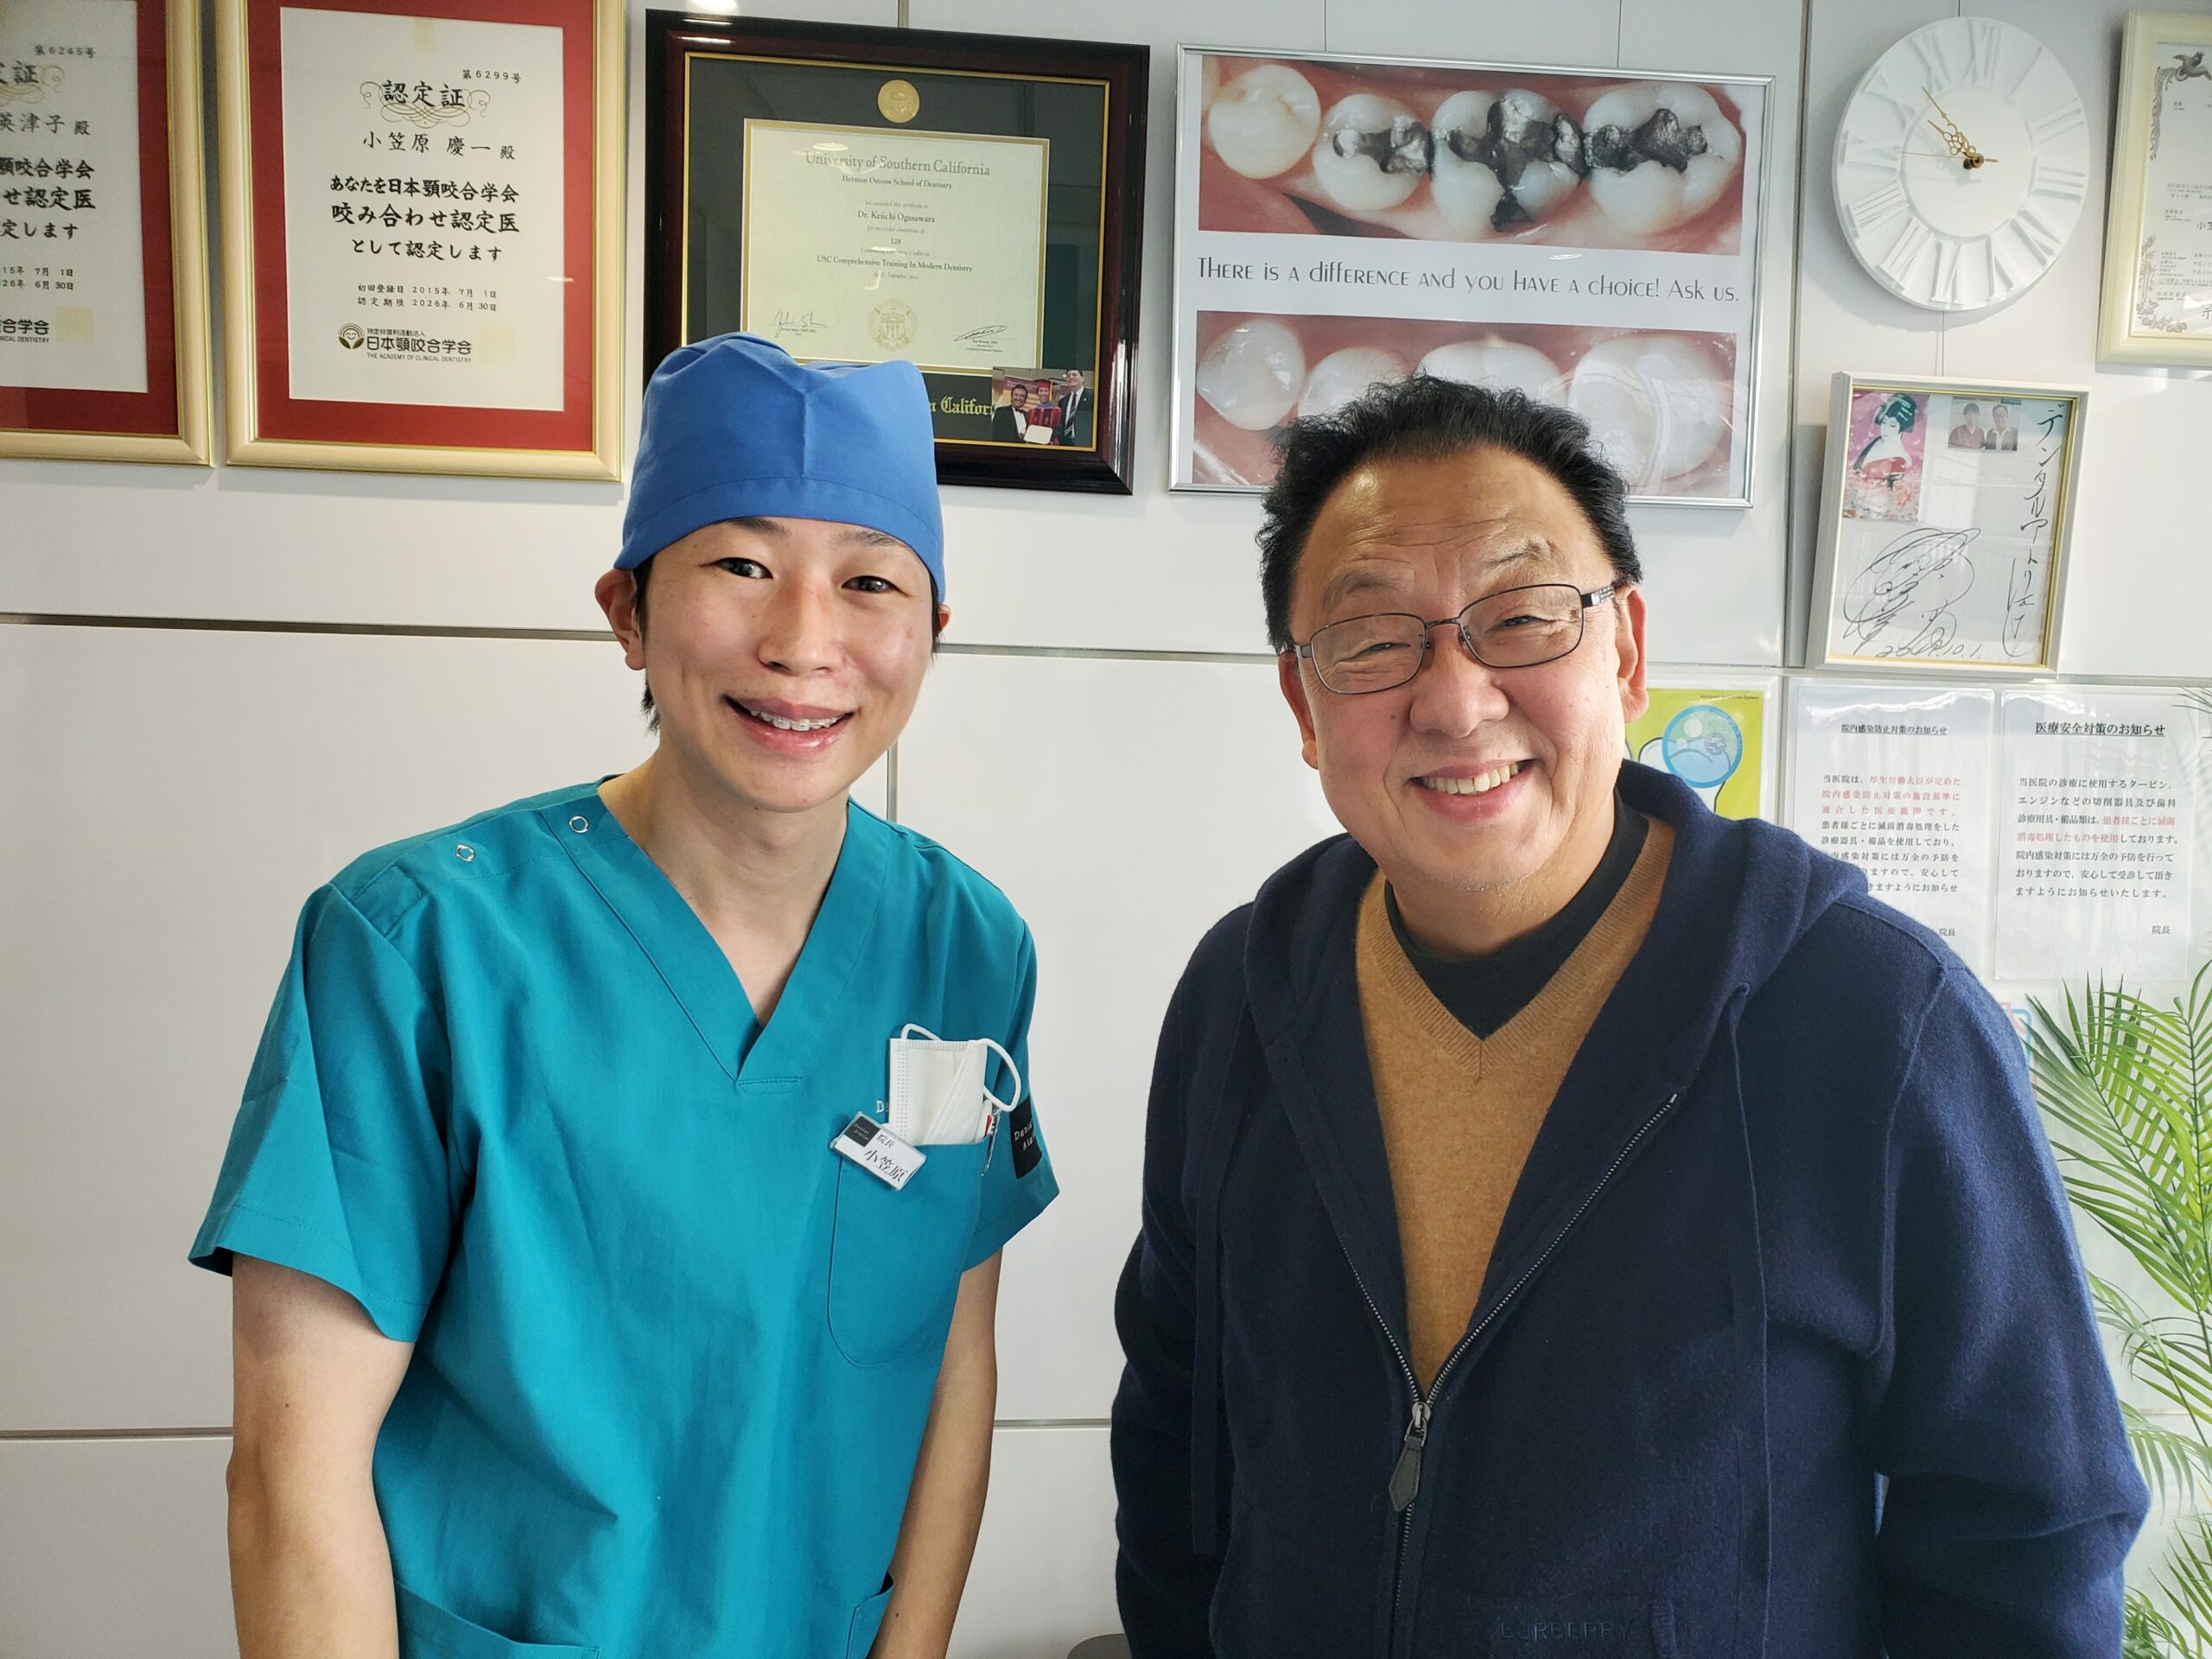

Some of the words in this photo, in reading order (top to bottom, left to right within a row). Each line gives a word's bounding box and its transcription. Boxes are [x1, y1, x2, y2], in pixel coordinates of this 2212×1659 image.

[462, 68, 522, 84] 第6299号
[383, 79, 467, 108] 認定証
[363, 131, 429, 154] 小笠原
[804, 150, 864, 170] University
[866, 155, 876, 168] of
[880, 156, 931, 172] Southern
[933, 159, 990, 176] California
[329, 175, 520, 204] あなたを日本顎咬合学会
[842, 175, 868, 184] Herman
[868, 176, 892, 186] Ostrow
[893, 177, 914, 187] School
[916, 179, 922, 188] of
[924, 180, 952, 190] Dentistry
[3, 187, 96, 211] せ認定医
[332, 201, 520, 233] 咬み合わせ認定医
[857, 210, 868, 219] Dr.
[871, 211, 896, 221] Keiichi
[897, 213, 935, 224] Ogasawara
[0, 219, 79, 239] 定します
[352, 238, 502, 262] として認定します
[891, 237, 901, 245] 128
[817, 255, 832, 264] USC
[833, 256, 880, 267] Comprehensive
[881, 258, 908, 270] Training
[909, 260, 917, 270] In
[918, 262, 943, 271] Modern
[944, 264, 973, 274] Dentistry
[0, 318, 49, 335] 合学会
[366, 336, 472, 355] 日本顎咬合学会
[378, 353, 406, 361] ACADEMY
[442, 355, 472, 364] DENTISTRY
[941, 395, 992, 416] Califor
[1841, 724, 1947, 734] 院内感染防止対策のお知らせ
[2035, 721, 2165, 736] 医療安全対策のお知らせ
[1827, 851, 1960, 862] 内感染対策には万全の予防を
[2016, 849, 2174, 862] 院内感染対策には万全の予防を行って
[2015, 887, 2167, 899] ますようにお知らせいたします。
[2152, 925, 2171, 935] 院長
[864, 1149, 908, 1182] 小笠原
